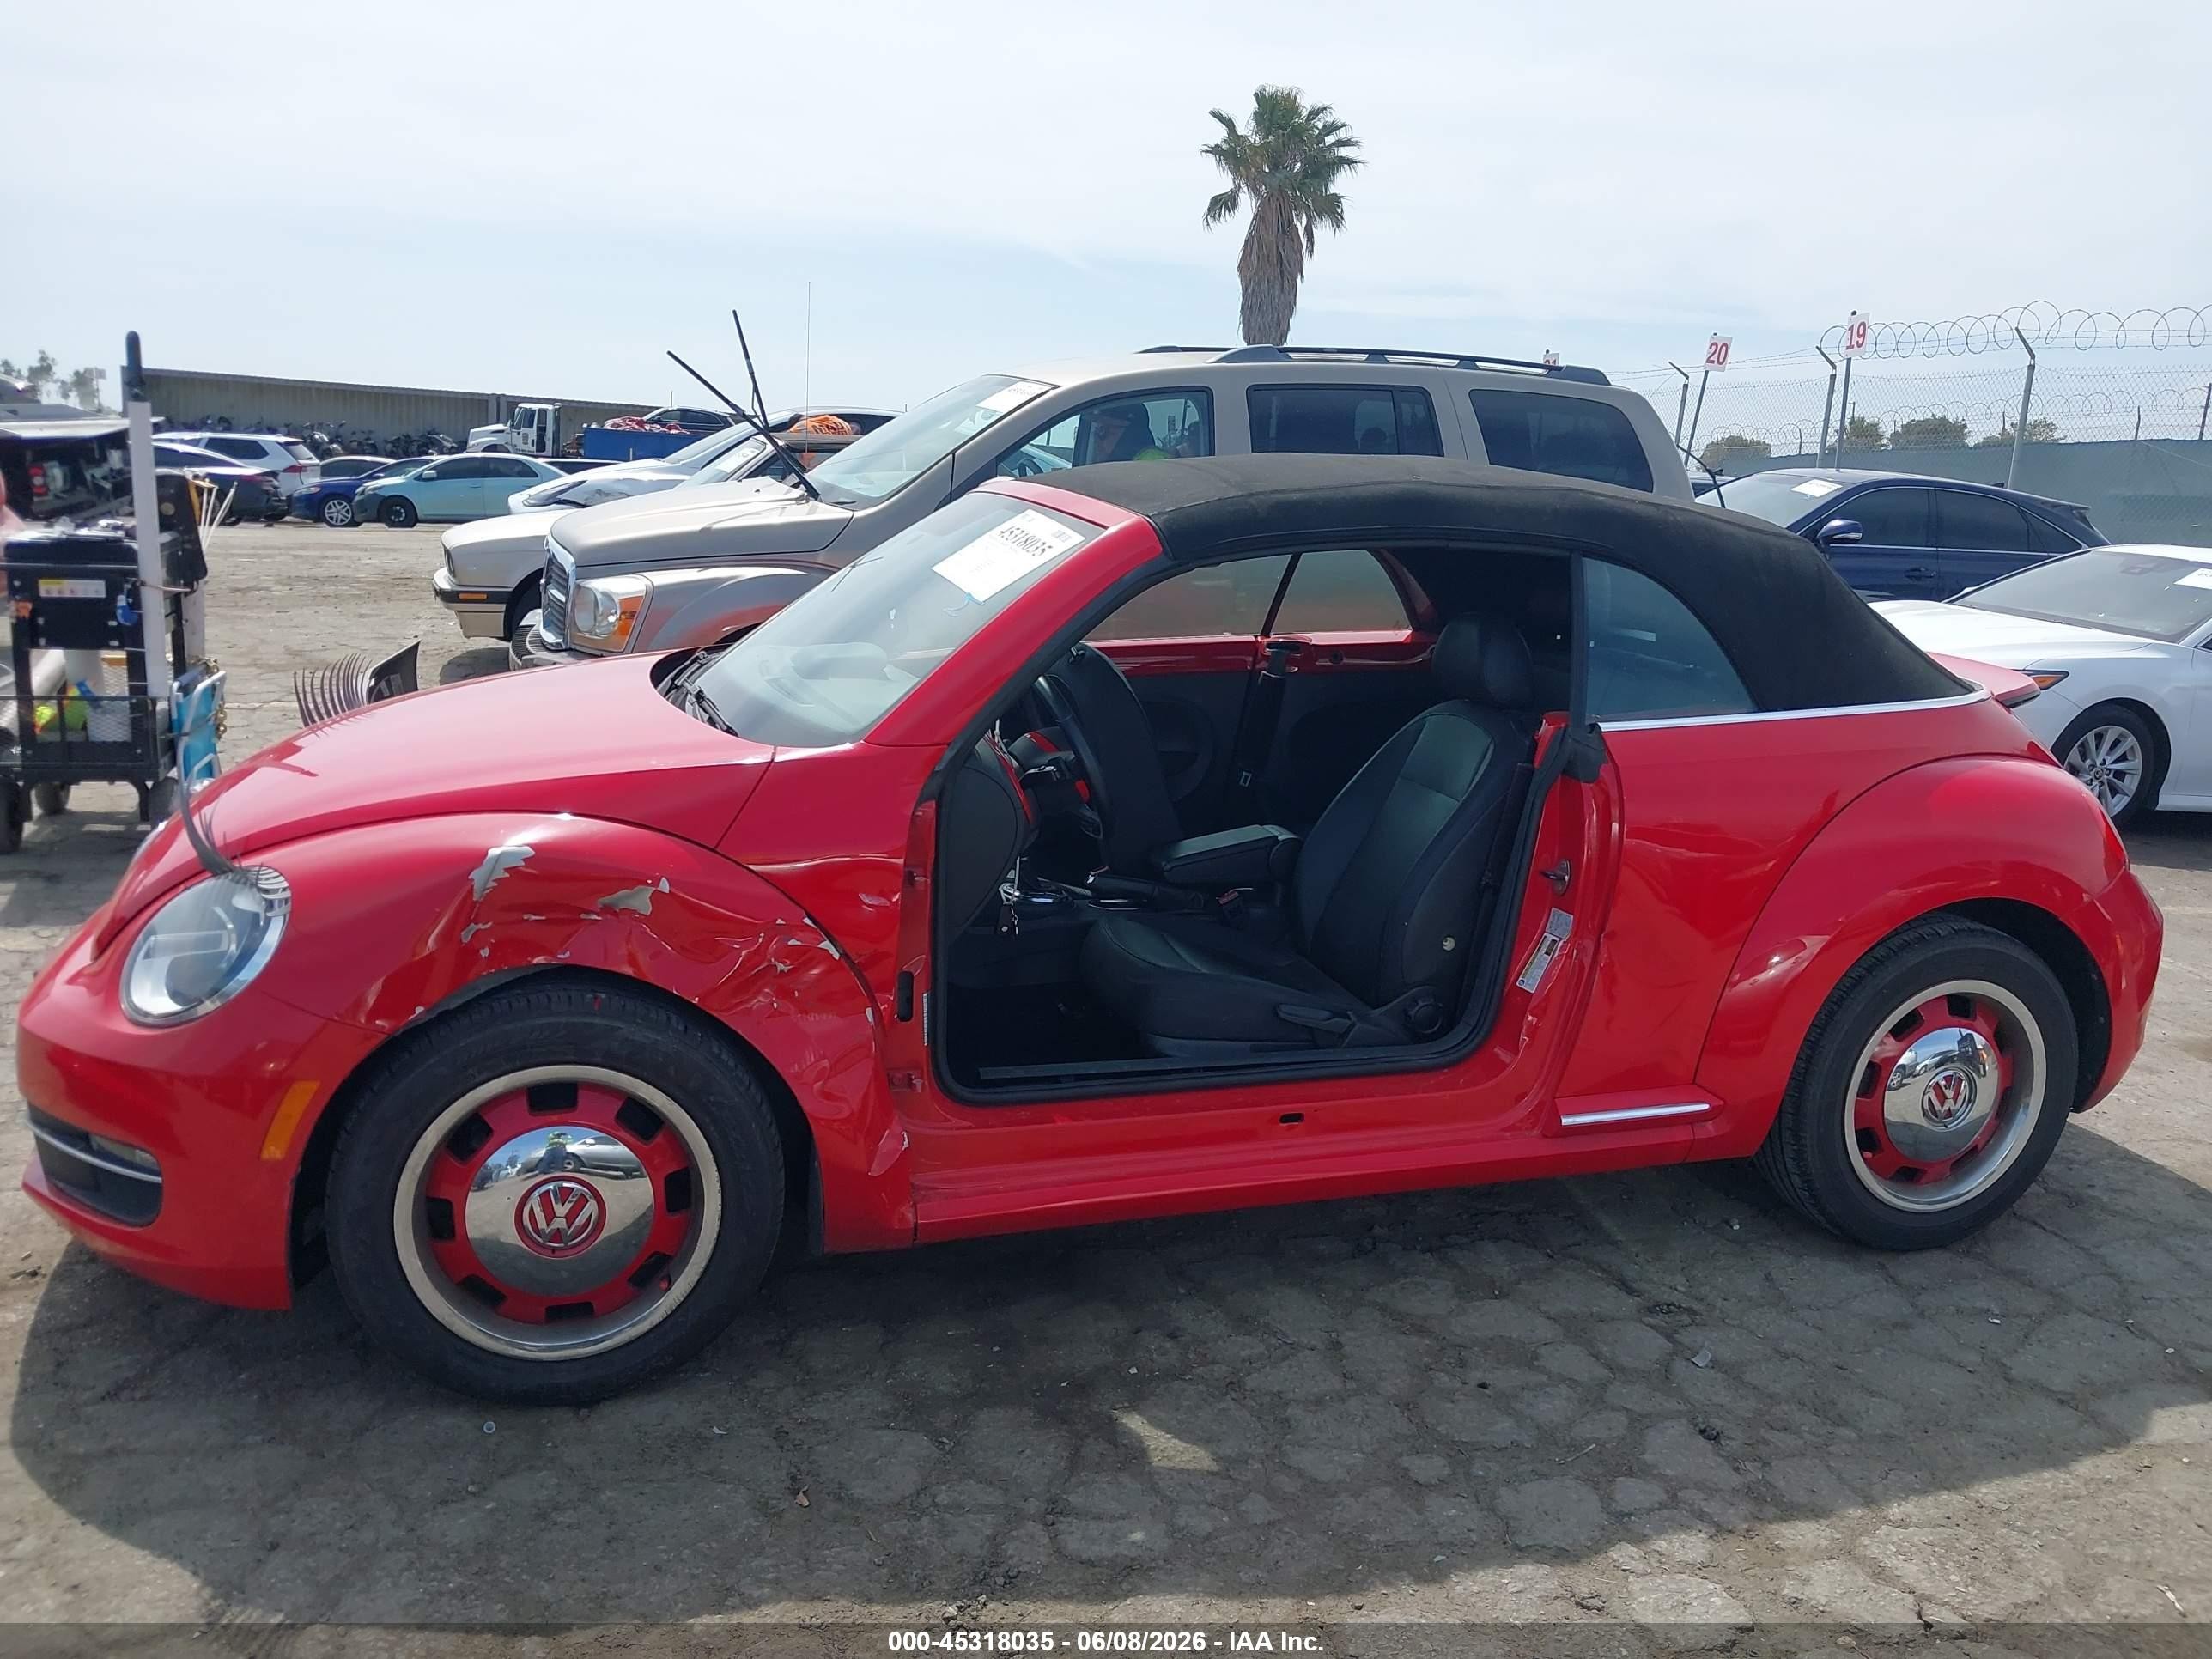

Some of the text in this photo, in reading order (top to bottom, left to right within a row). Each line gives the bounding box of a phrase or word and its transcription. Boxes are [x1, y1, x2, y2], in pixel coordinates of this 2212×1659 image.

[1844, 321, 1868, 350] 19
[1705, 342, 1729, 366] 20
[998, 526, 1054, 557] 45318035
[1924, 1071, 1971, 1121] VW
[523, 1182, 598, 1246] VW
